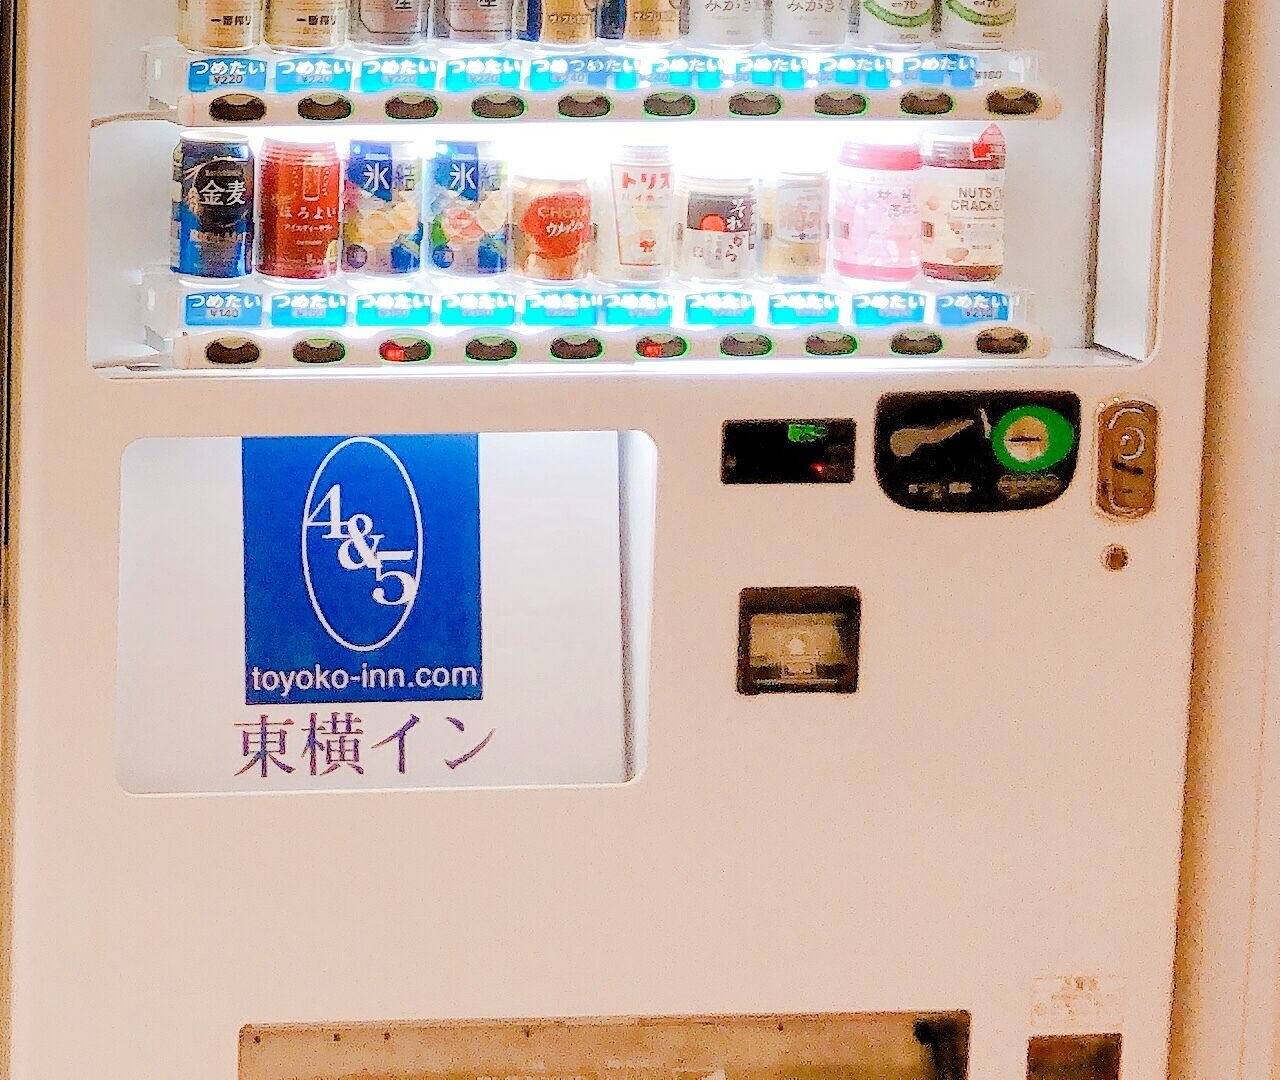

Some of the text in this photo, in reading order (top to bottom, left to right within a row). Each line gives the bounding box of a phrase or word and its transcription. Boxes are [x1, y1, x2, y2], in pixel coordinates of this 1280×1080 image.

[191, 61, 266, 75] つめたい
[278, 61, 351, 75] つめたい
[820, 58, 891, 72] つめたい
[904, 58, 975, 72] つめたい
[213, 74, 242, 84] ¥220
[199, 180, 245, 206] 金麦
[188, 293, 261, 309] つめたい
[272, 293, 346, 309] つめたい
[855, 293, 926, 308] つめたい
[939, 293, 1012, 308] つめたい
[305, 484, 415, 607] 4&5
[252, 663, 477, 696] toyoko-inn.com
[234, 713, 497, 778] 東横イン
